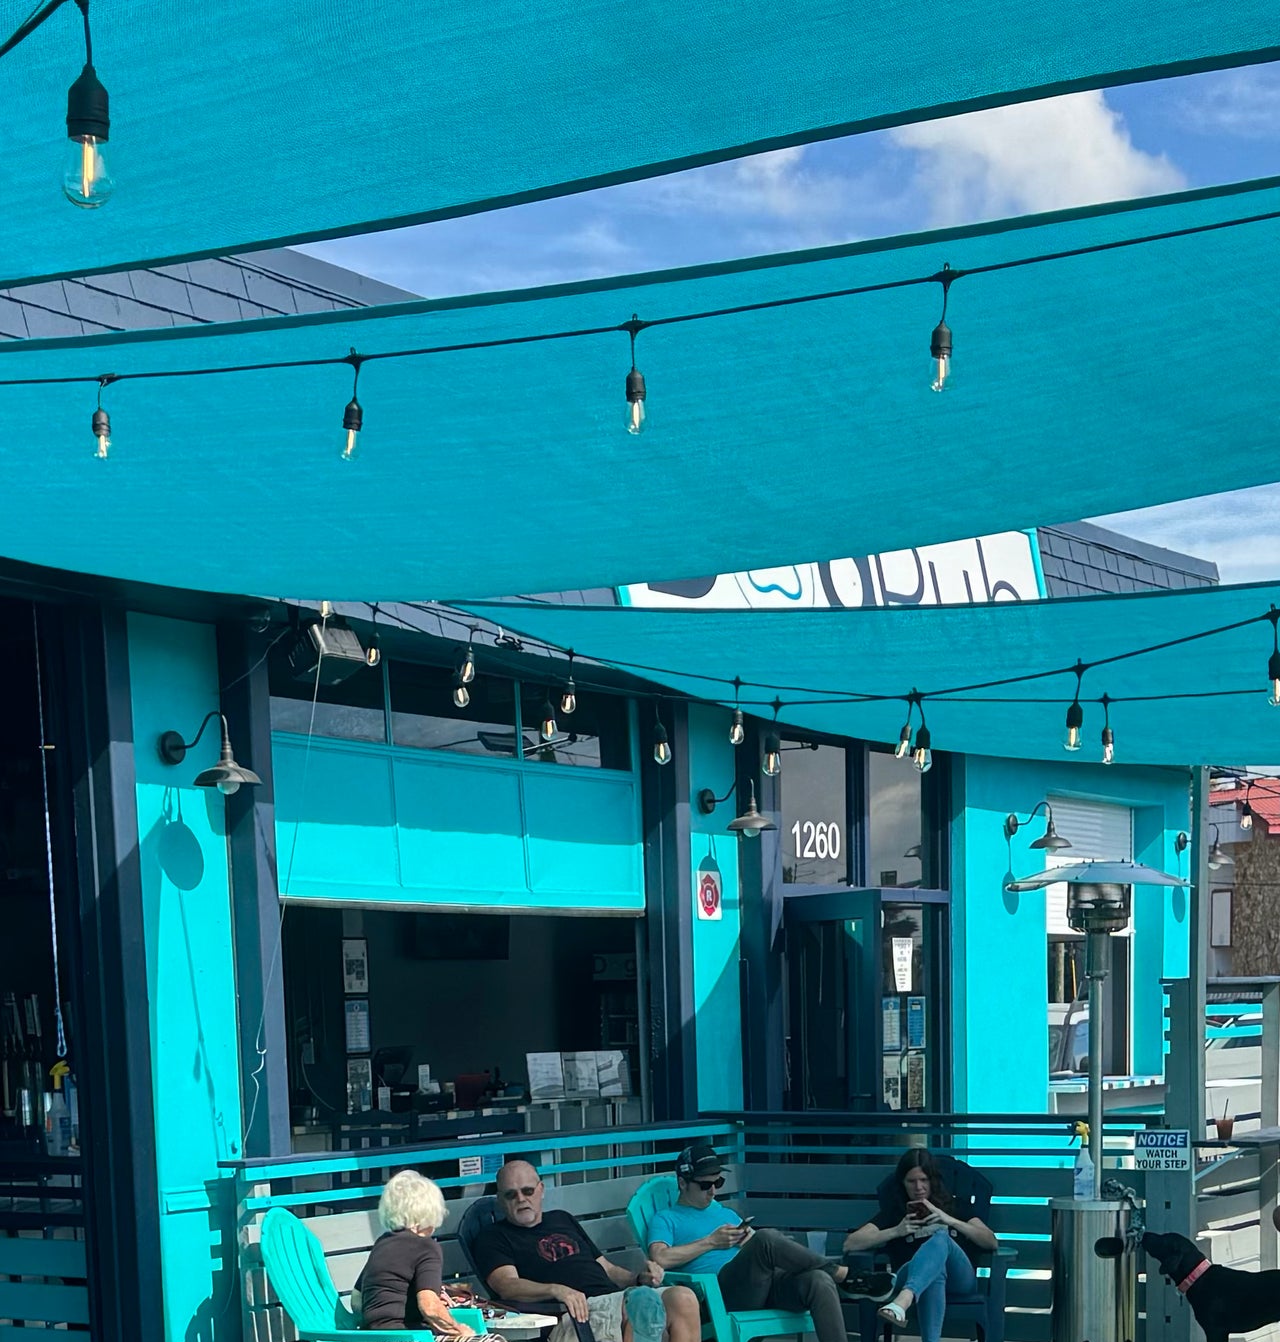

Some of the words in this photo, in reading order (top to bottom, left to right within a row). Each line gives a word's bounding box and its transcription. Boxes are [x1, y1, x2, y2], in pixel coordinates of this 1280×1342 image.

[791, 820, 841, 859] 1260
[1137, 1134, 1186, 1146] NOTICE
[1146, 1149, 1178, 1158] WATCH
[1136, 1159, 1161, 1169] YOUR
[1164, 1159, 1187, 1169] STEP
